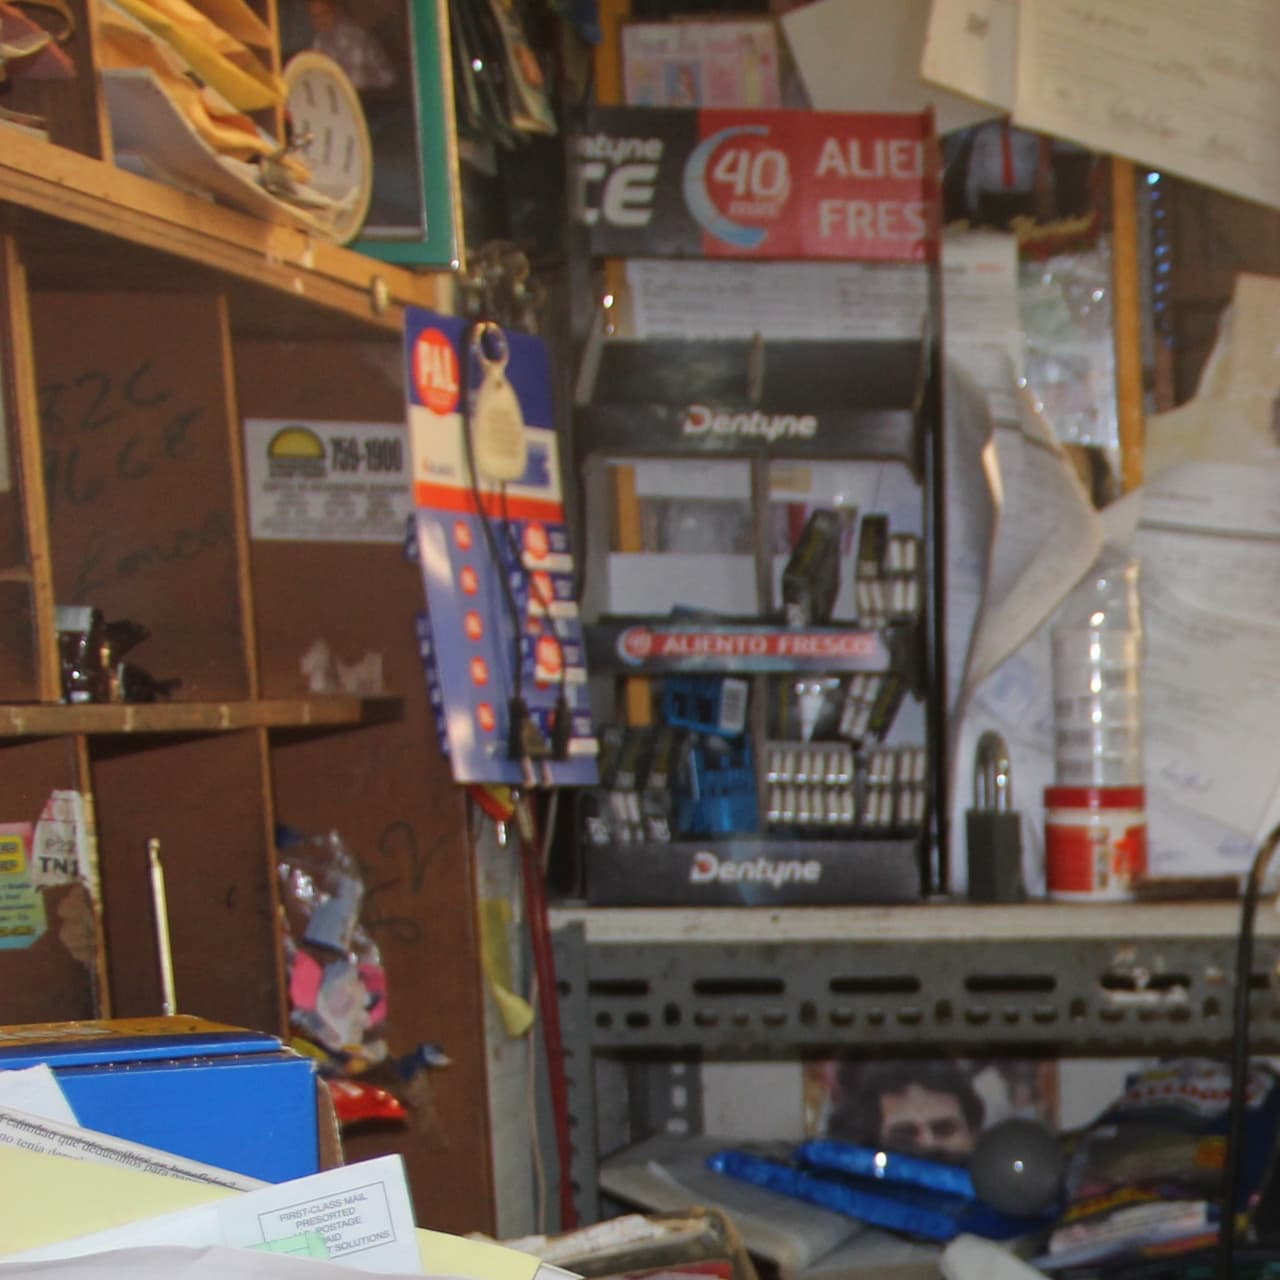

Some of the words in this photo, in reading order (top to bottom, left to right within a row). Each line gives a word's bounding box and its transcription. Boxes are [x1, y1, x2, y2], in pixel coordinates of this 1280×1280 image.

[713, 148, 791, 197] 40
[418, 340, 460, 393] PAL
[683, 402, 819, 442] Dentyne
[661, 633, 767, 657] ALIENTO
[688, 851, 822, 890] Dentyne
[279, 1198, 343, 1224] FIRST-CLASS
[343, 1193, 368, 1208] MAIL
[295, 1207, 357, 1230] PRESORTED
[315, 1216, 363, 1235] POSTAGE
[335, 1230, 392, 1253] SOLUTIONS
